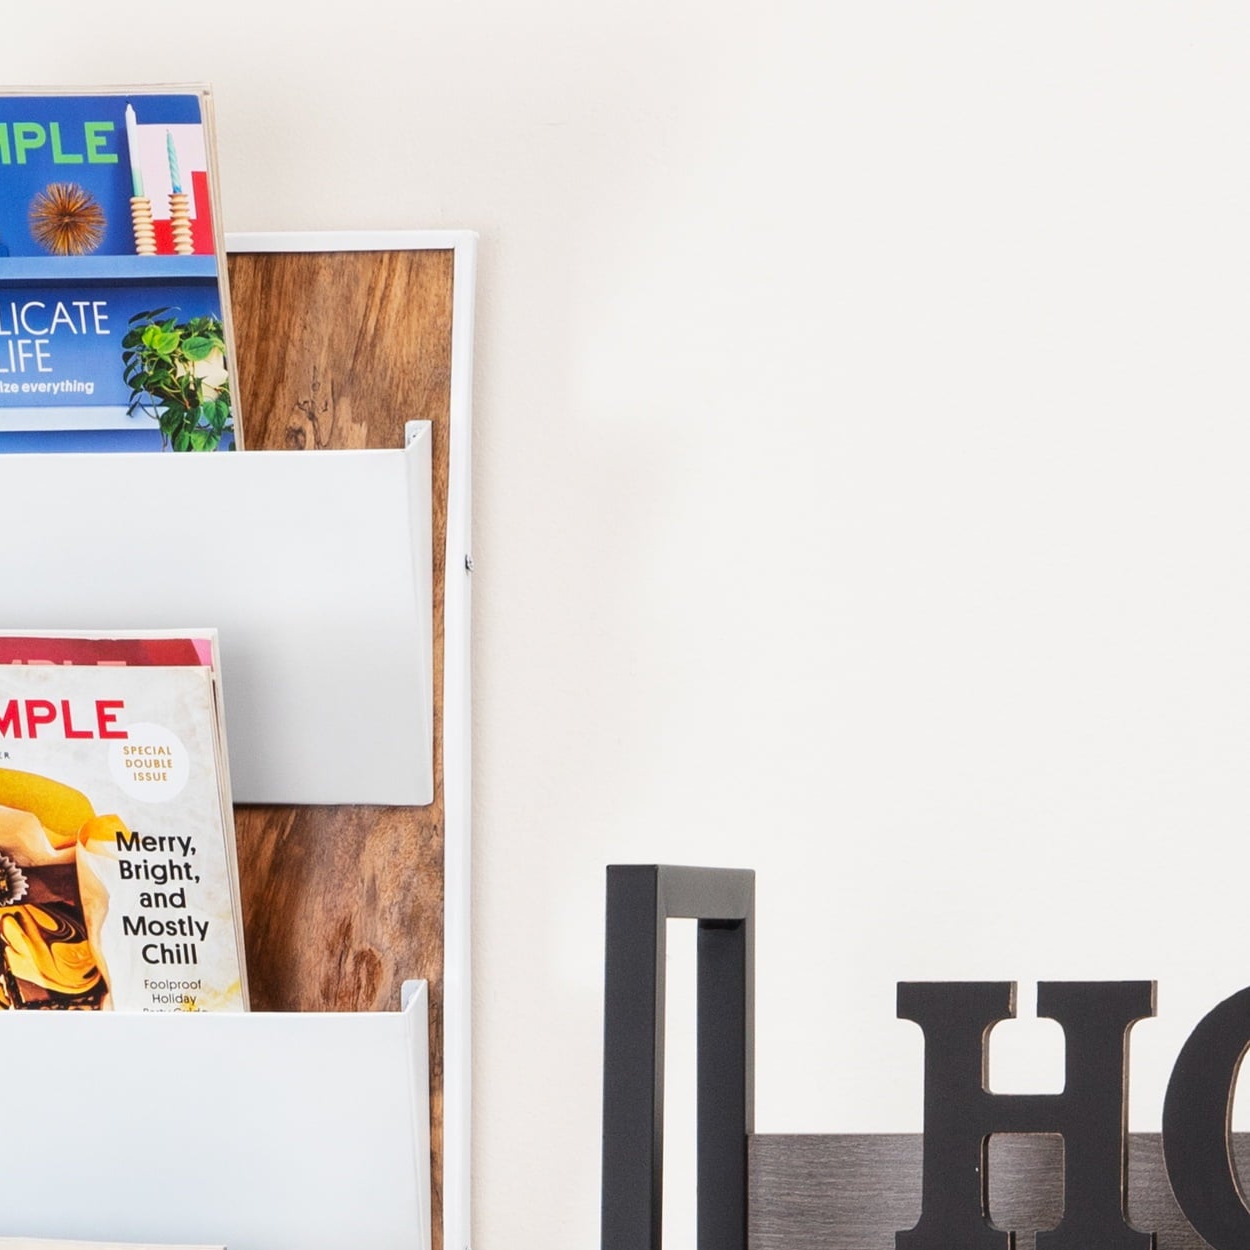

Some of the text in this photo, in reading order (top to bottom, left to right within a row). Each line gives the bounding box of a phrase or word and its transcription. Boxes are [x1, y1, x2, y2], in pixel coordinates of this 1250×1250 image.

[21, 379, 95, 396] everything
[123, 746, 172, 756] SPECIAL
[125, 759, 173, 769] DOUBLE
[133, 772, 168, 782] ISSUE
[115, 831, 196, 857] Merry,
[119, 858, 200, 885] Bright,
[139, 887, 186, 908] and
[122, 915, 209, 941] Mostly
[141, 943, 198, 965] Chill
[144, 979, 202, 991] Foolproof
[152, 993, 197, 1006] Holiday
